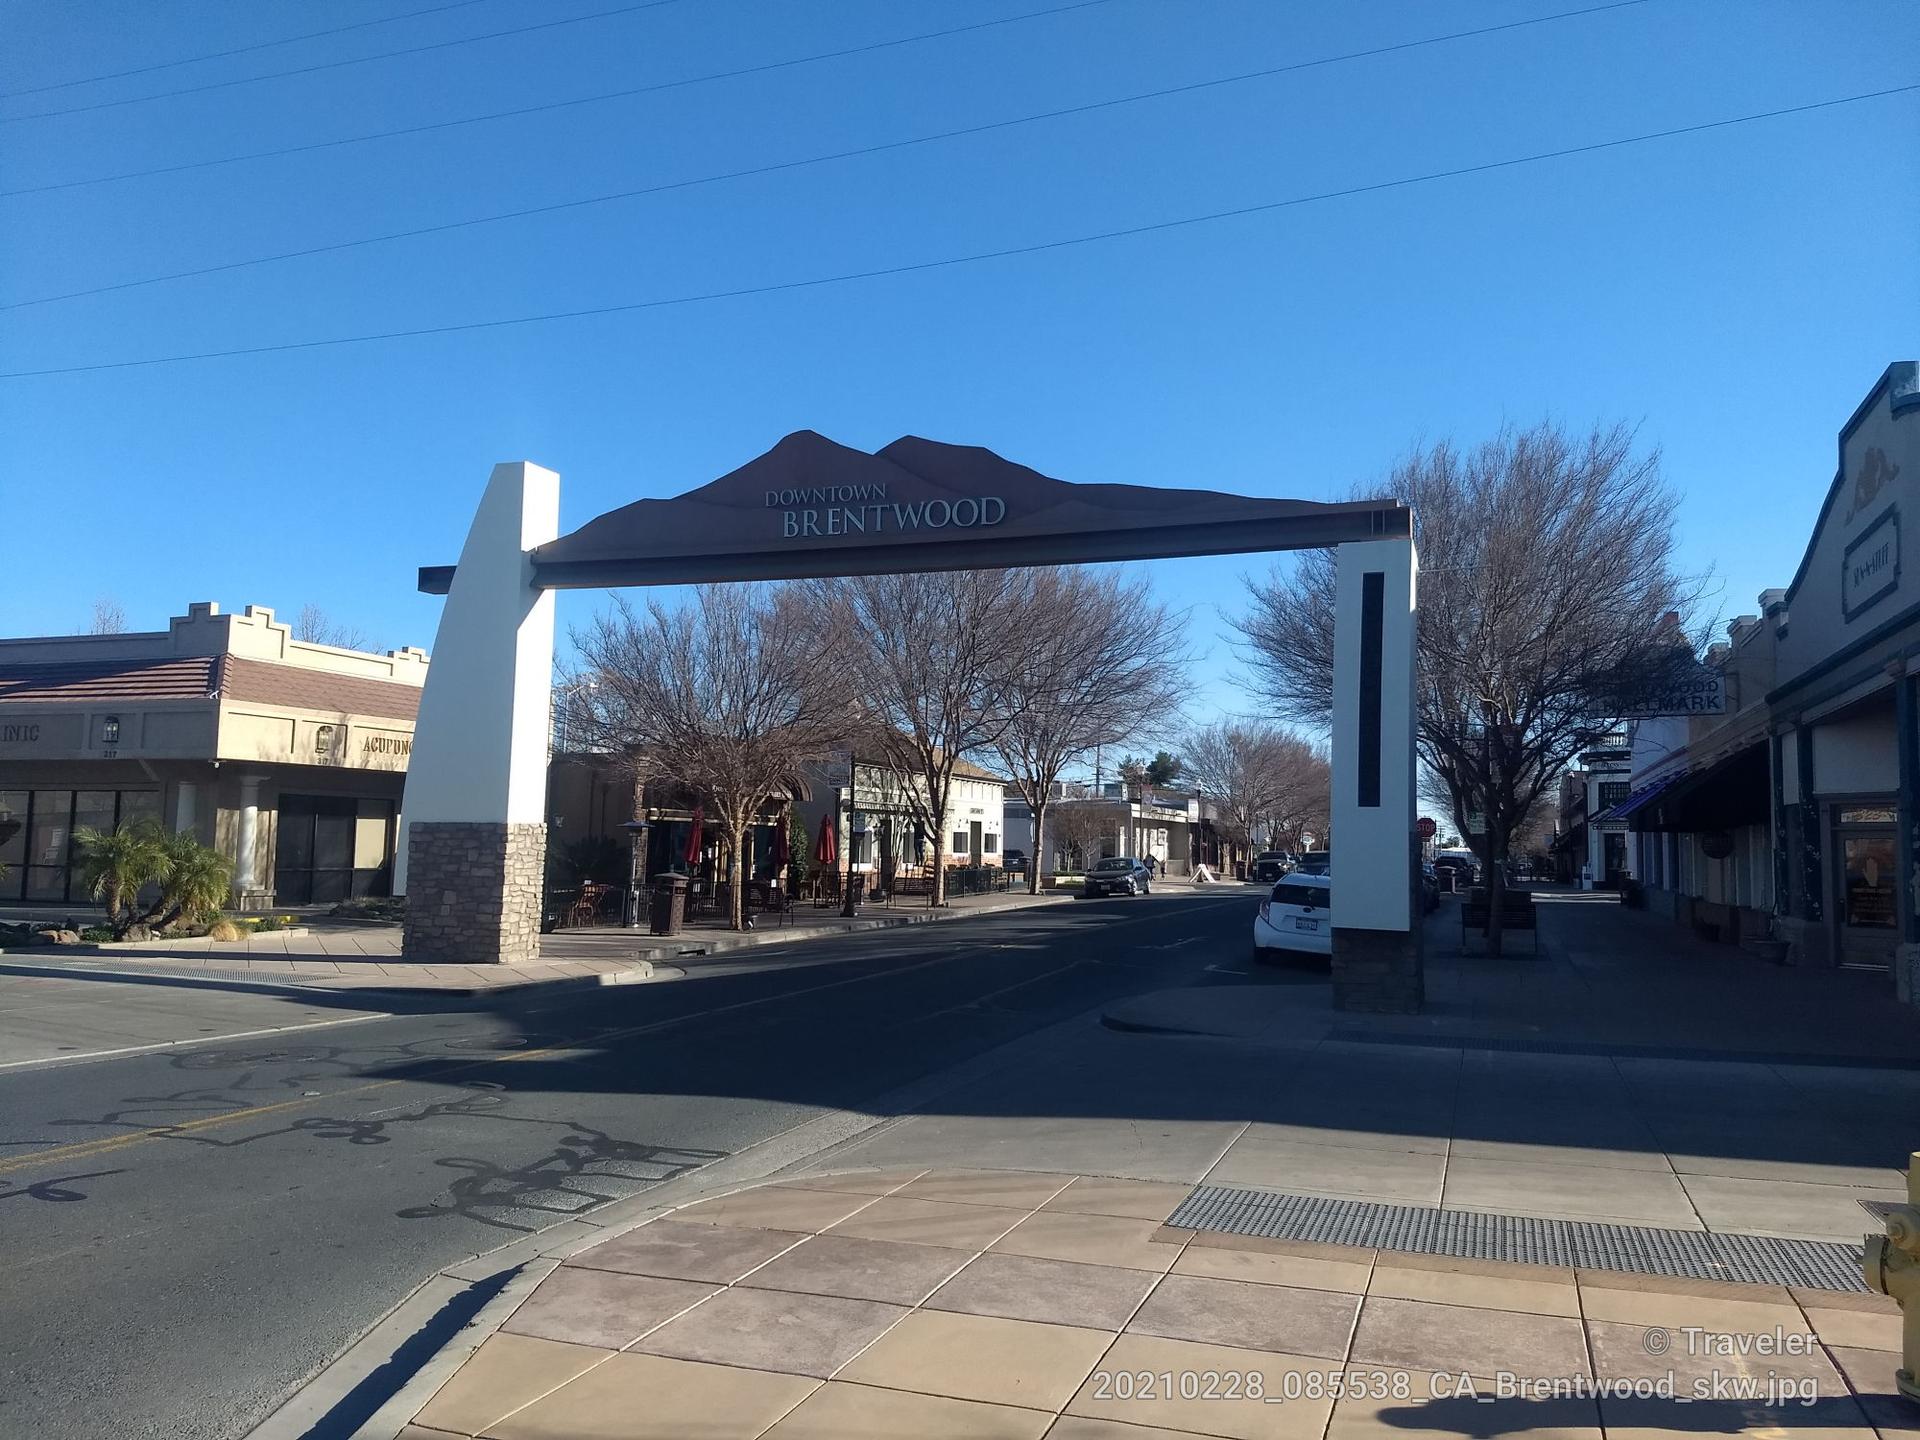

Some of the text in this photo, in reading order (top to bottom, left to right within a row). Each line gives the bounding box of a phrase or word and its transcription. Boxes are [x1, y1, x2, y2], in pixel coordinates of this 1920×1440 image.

[765, 483, 886, 507] DOWNTOWN
[783, 496, 1006, 538] BRENTWOOD
[0, 724, 40, 742] INIC
[1416, 823, 1435, 832] STOP
